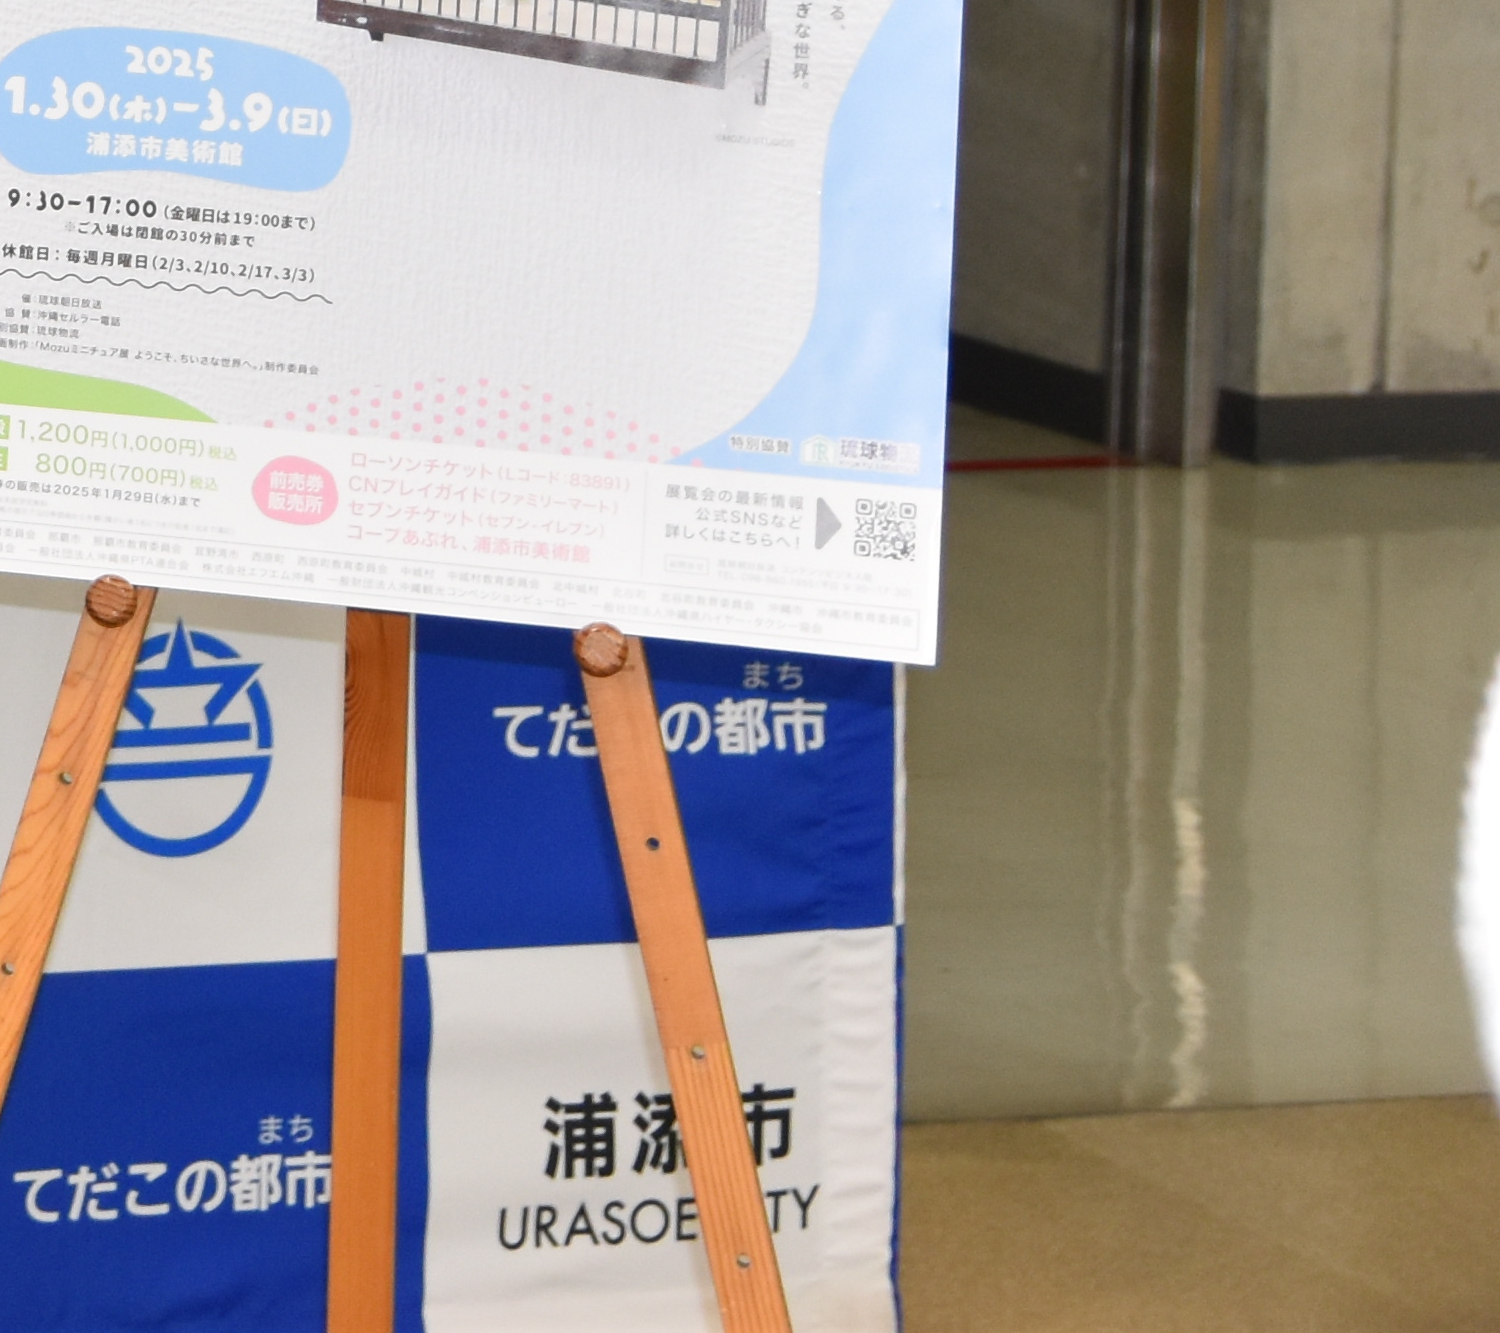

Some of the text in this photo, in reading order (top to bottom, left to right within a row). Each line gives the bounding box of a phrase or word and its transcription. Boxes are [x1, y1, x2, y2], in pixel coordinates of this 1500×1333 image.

[125, 45, 215, 81] 2025
[86, 132, 244, 167] 浦添市美術館
[729, 436, 790, 454] 特別協賛
[269, 471, 326, 494] 前売券
[268, 492, 324, 514] 販売所
[665, 483, 805, 511] 展覧会の最新情報
[695, 507, 803, 531] 公式SNSなど
[743, 662, 804, 690] まち
[494, 698, 826, 757] てだの都市
[258, 1115, 313, 1144] まち
[14, 1151, 332, 1222] てだこの都市
[500, 1184, 820, 1250] URASOE TY
